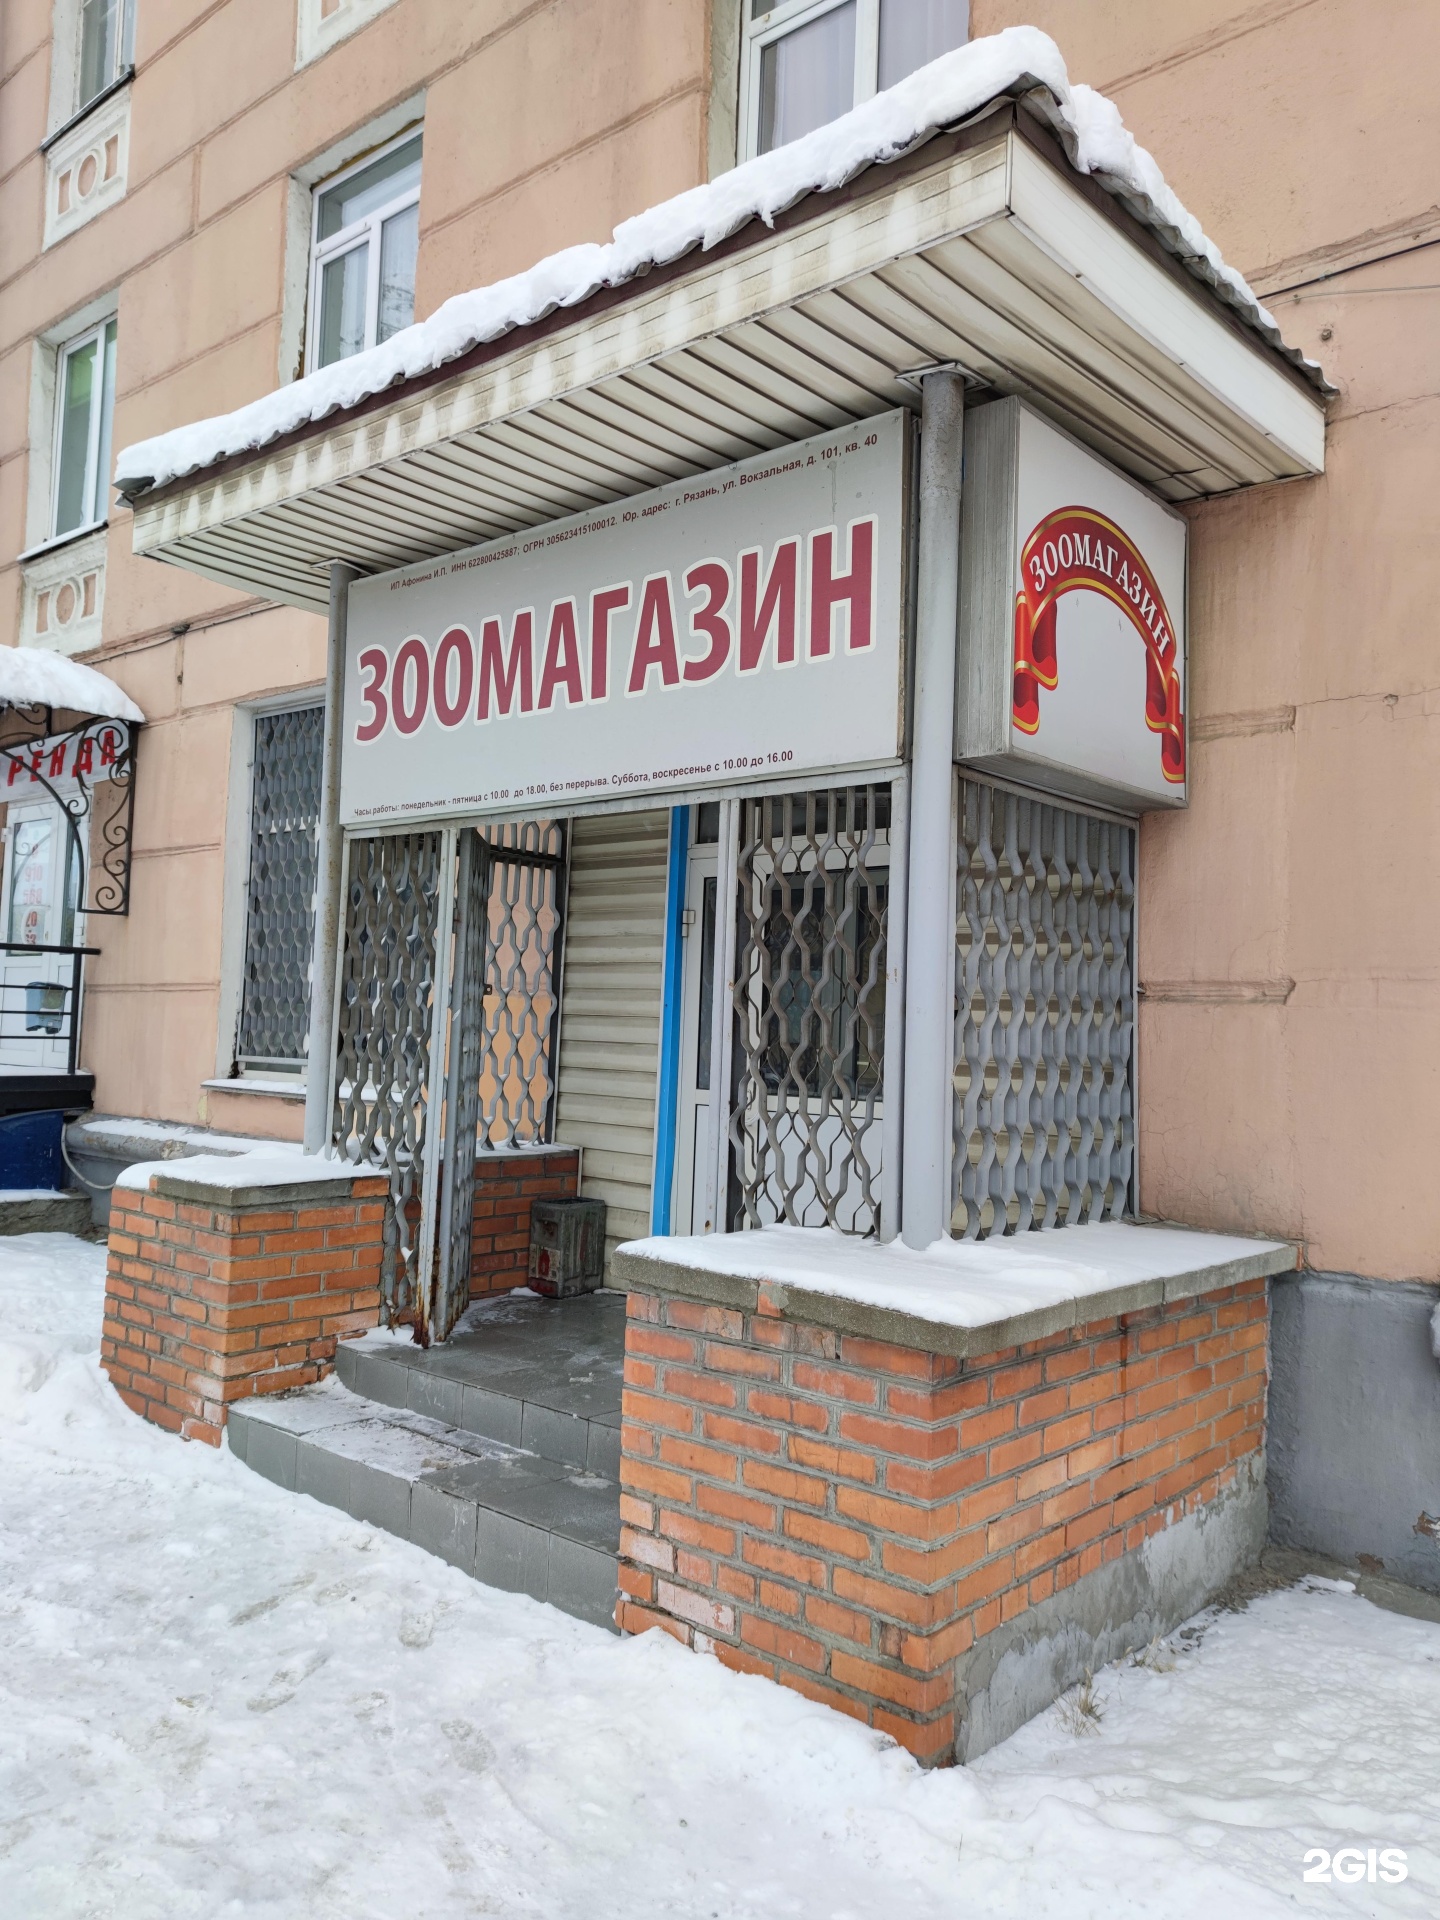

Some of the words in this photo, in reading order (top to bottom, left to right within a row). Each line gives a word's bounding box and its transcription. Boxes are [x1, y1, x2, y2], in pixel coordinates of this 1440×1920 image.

[390, 580, 400, 591] ИП
[402, 573, 432, 588] Афонина
[433, 567, 448, 578] И.П.
[451, 561, 467, 573] ИНН
[468, 546, 520, 568] 622800425887;
[523, 538, 545, 554] ОГРН
[546, 517, 618, 546] 305623415100012.
[622, 511, 639, 523] Юр.
[641, 501, 671, 518] адрес:
[683, 486, 720, 504] Рязань,
[722, 479, 737, 493] ул.
[740, 458, 804, 486] Вокзальная,
[806, 454, 817, 467] д.
[820, 445, 842, 461] 101,
[845, 441, 861, 454] кв.
[864, 433, 878, 447] 40
[355, 518, 875, 744] ЗООМАГАЗИН
[1029, 532, 1171, 658] ЗООМАГАЗИН
[353, 808, 372, 817] Часы
[372, 803, 400, 816] работы:
[400, 799, 446, 811] понедельник
[452, 793, 482, 805] пятница
[483, 793, 489, 801] с
[490, 789, 509, 800] 10.00
[513, 789, 524, 798] до
[526, 784, 548, 795] 18.00,
[550, 782, 564, 792] без
[565, 777, 609, 790] перерыва.
[611, 773, 651, 786] Суббота,
[652, 764, 712, 780] воскресенье
[714, 763, 720, 771] с
[722, 757, 748, 770] 10.00
[750, 757, 763, 767] до
[766, 750, 793, 764] 16.00
